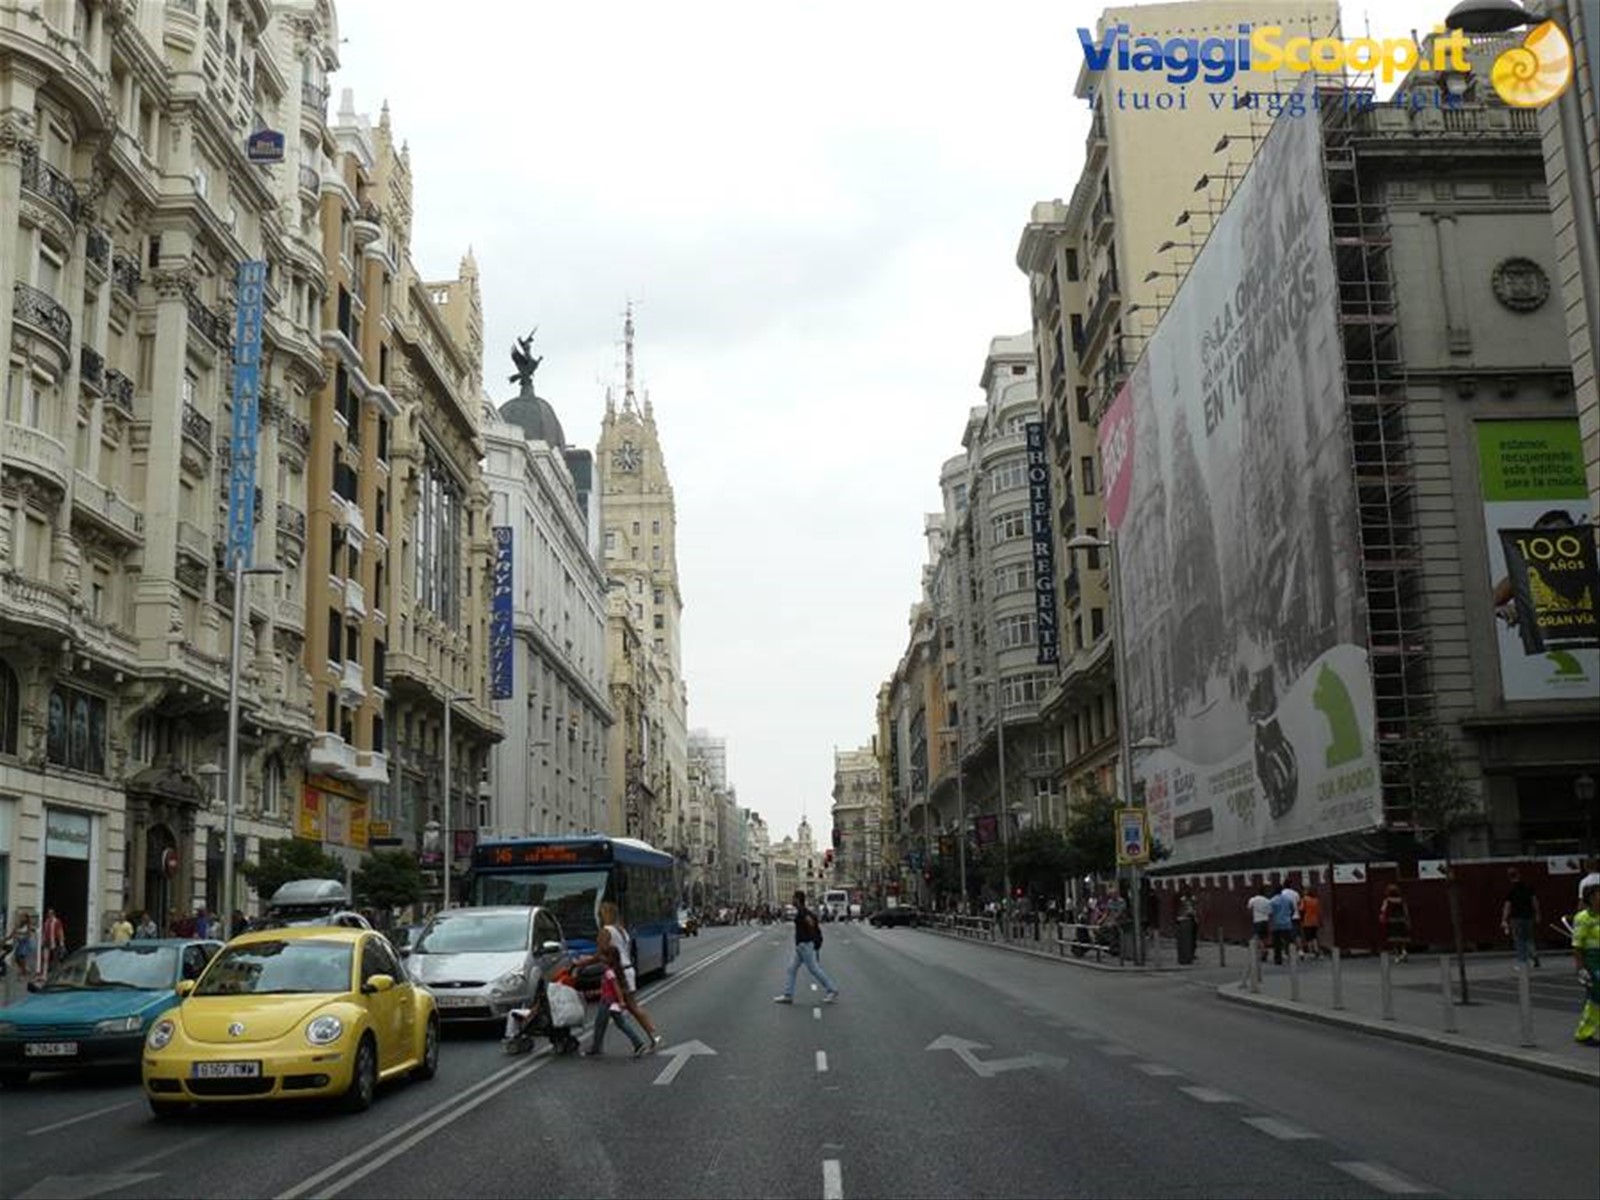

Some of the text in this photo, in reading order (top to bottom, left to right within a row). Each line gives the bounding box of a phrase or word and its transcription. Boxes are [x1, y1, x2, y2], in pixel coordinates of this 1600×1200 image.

[241, 265, 263, 364] HOTEL
[1203, 379, 1226, 438] EN
[1029, 451, 1055, 662] HOTEL REGENTE
[1516, 535, 1581, 560] 100
[1549, 559, 1585, 571] AÑOS
[494, 548, 512, 597] TRYP
[1536, 614, 1574, 627] GRAN
